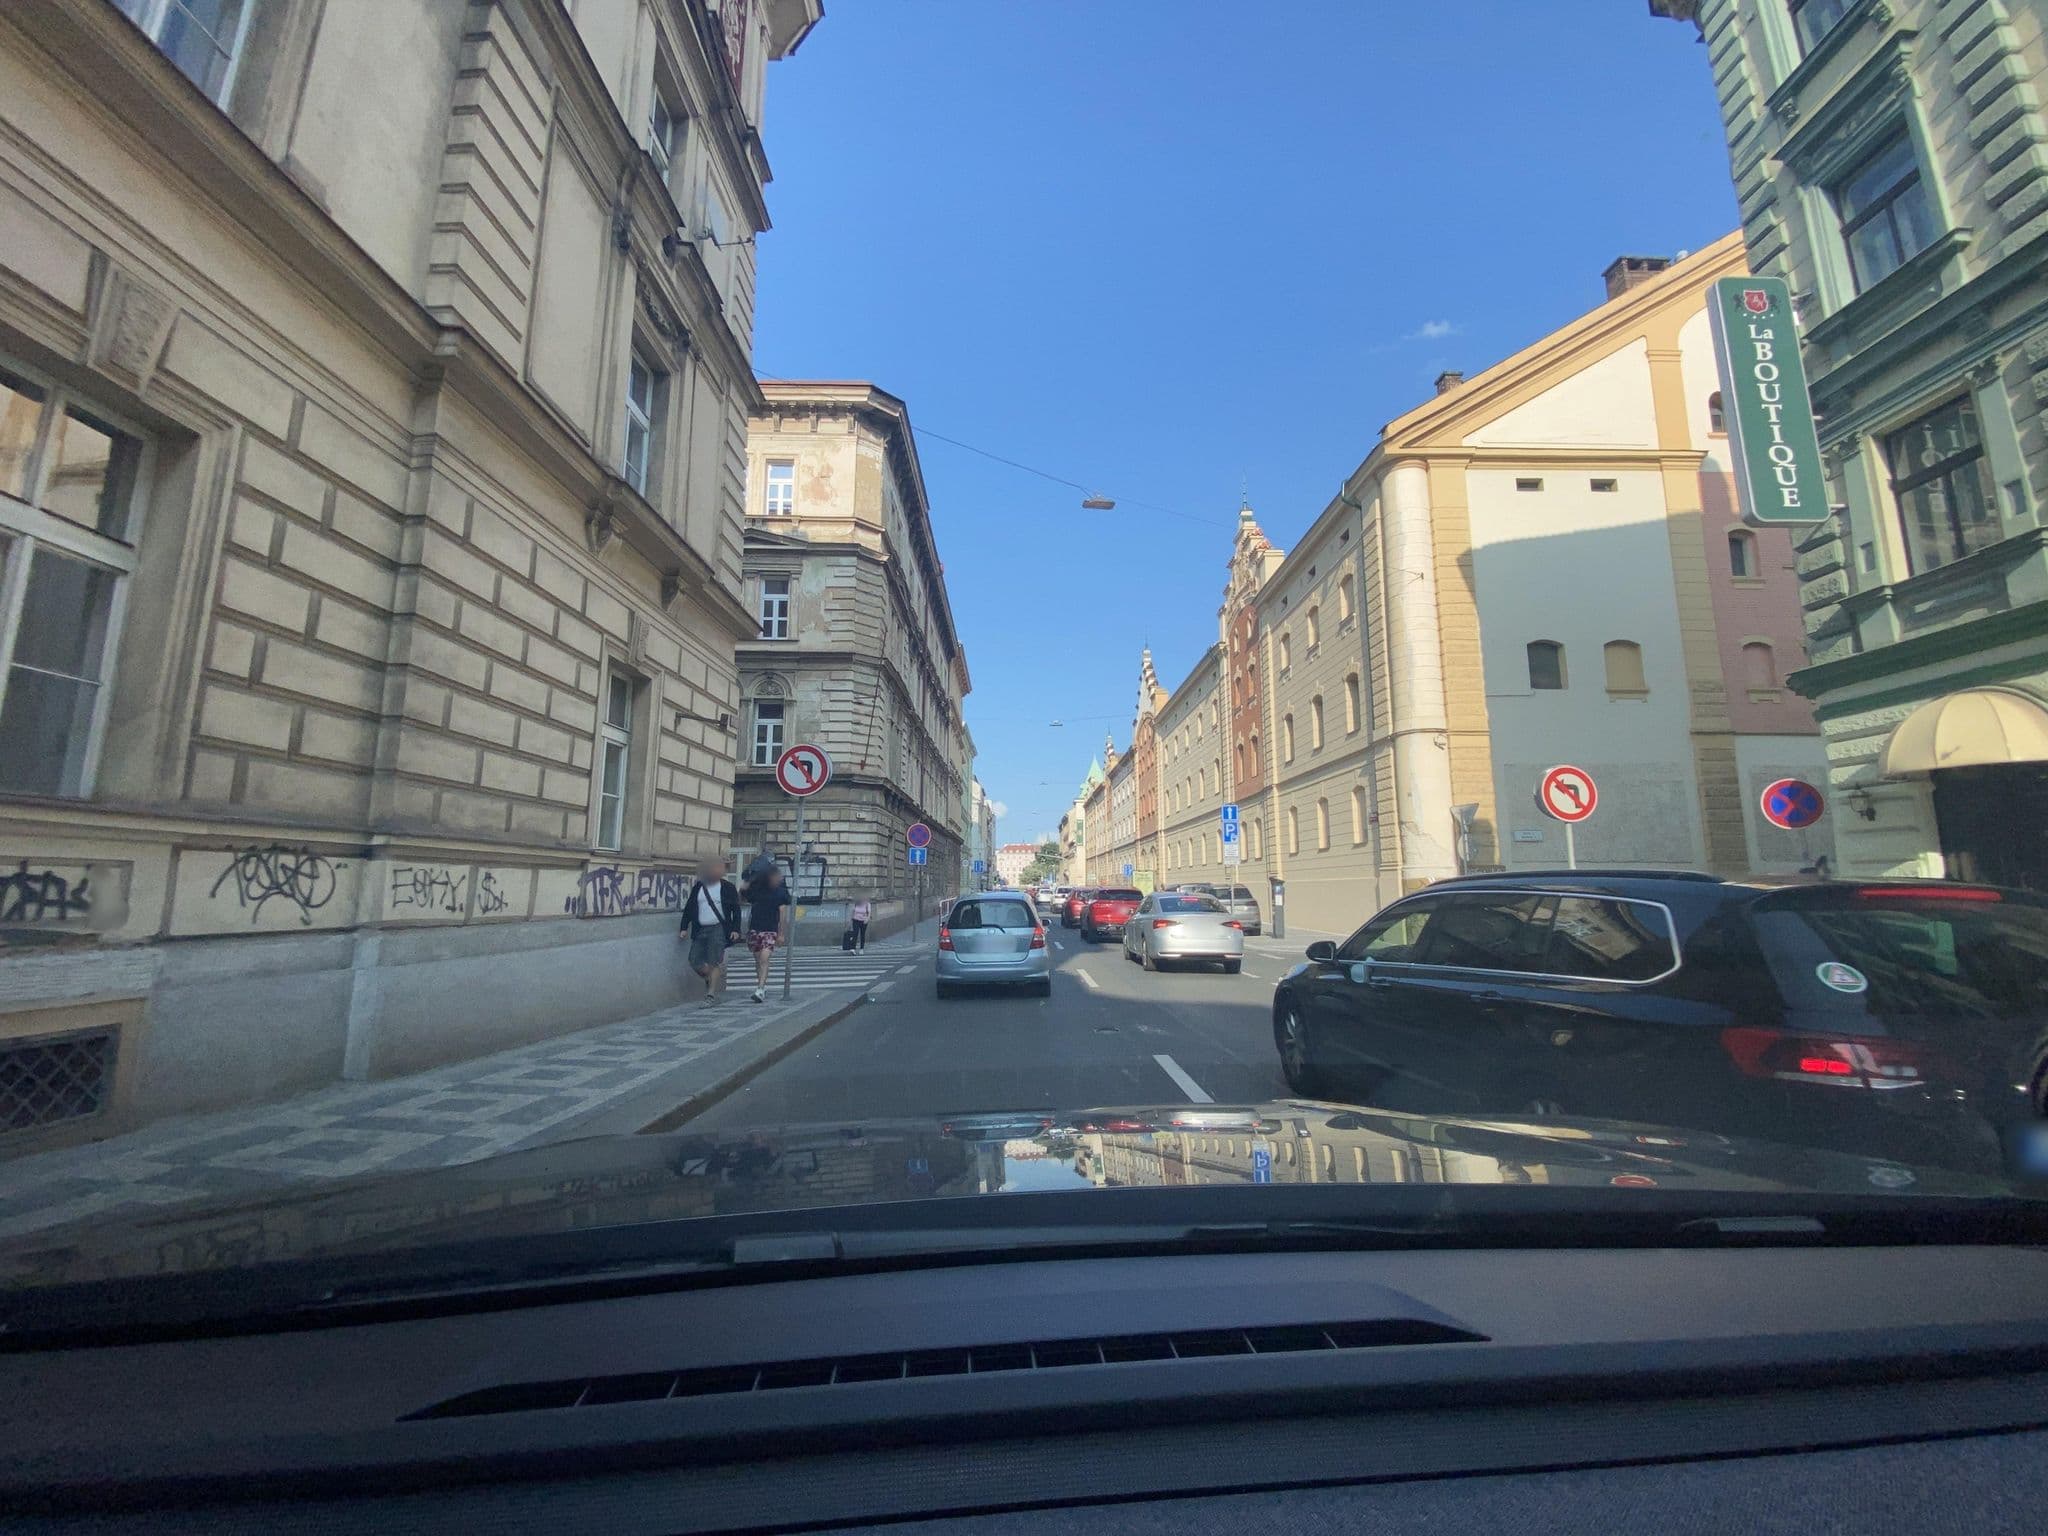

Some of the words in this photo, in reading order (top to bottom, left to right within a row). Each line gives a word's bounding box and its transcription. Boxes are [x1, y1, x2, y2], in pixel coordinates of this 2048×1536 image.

[1748, 324, 1774, 340] La
[1753, 342, 1800, 507] BOUTIQUE
[1226, 823, 1236, 838] P
